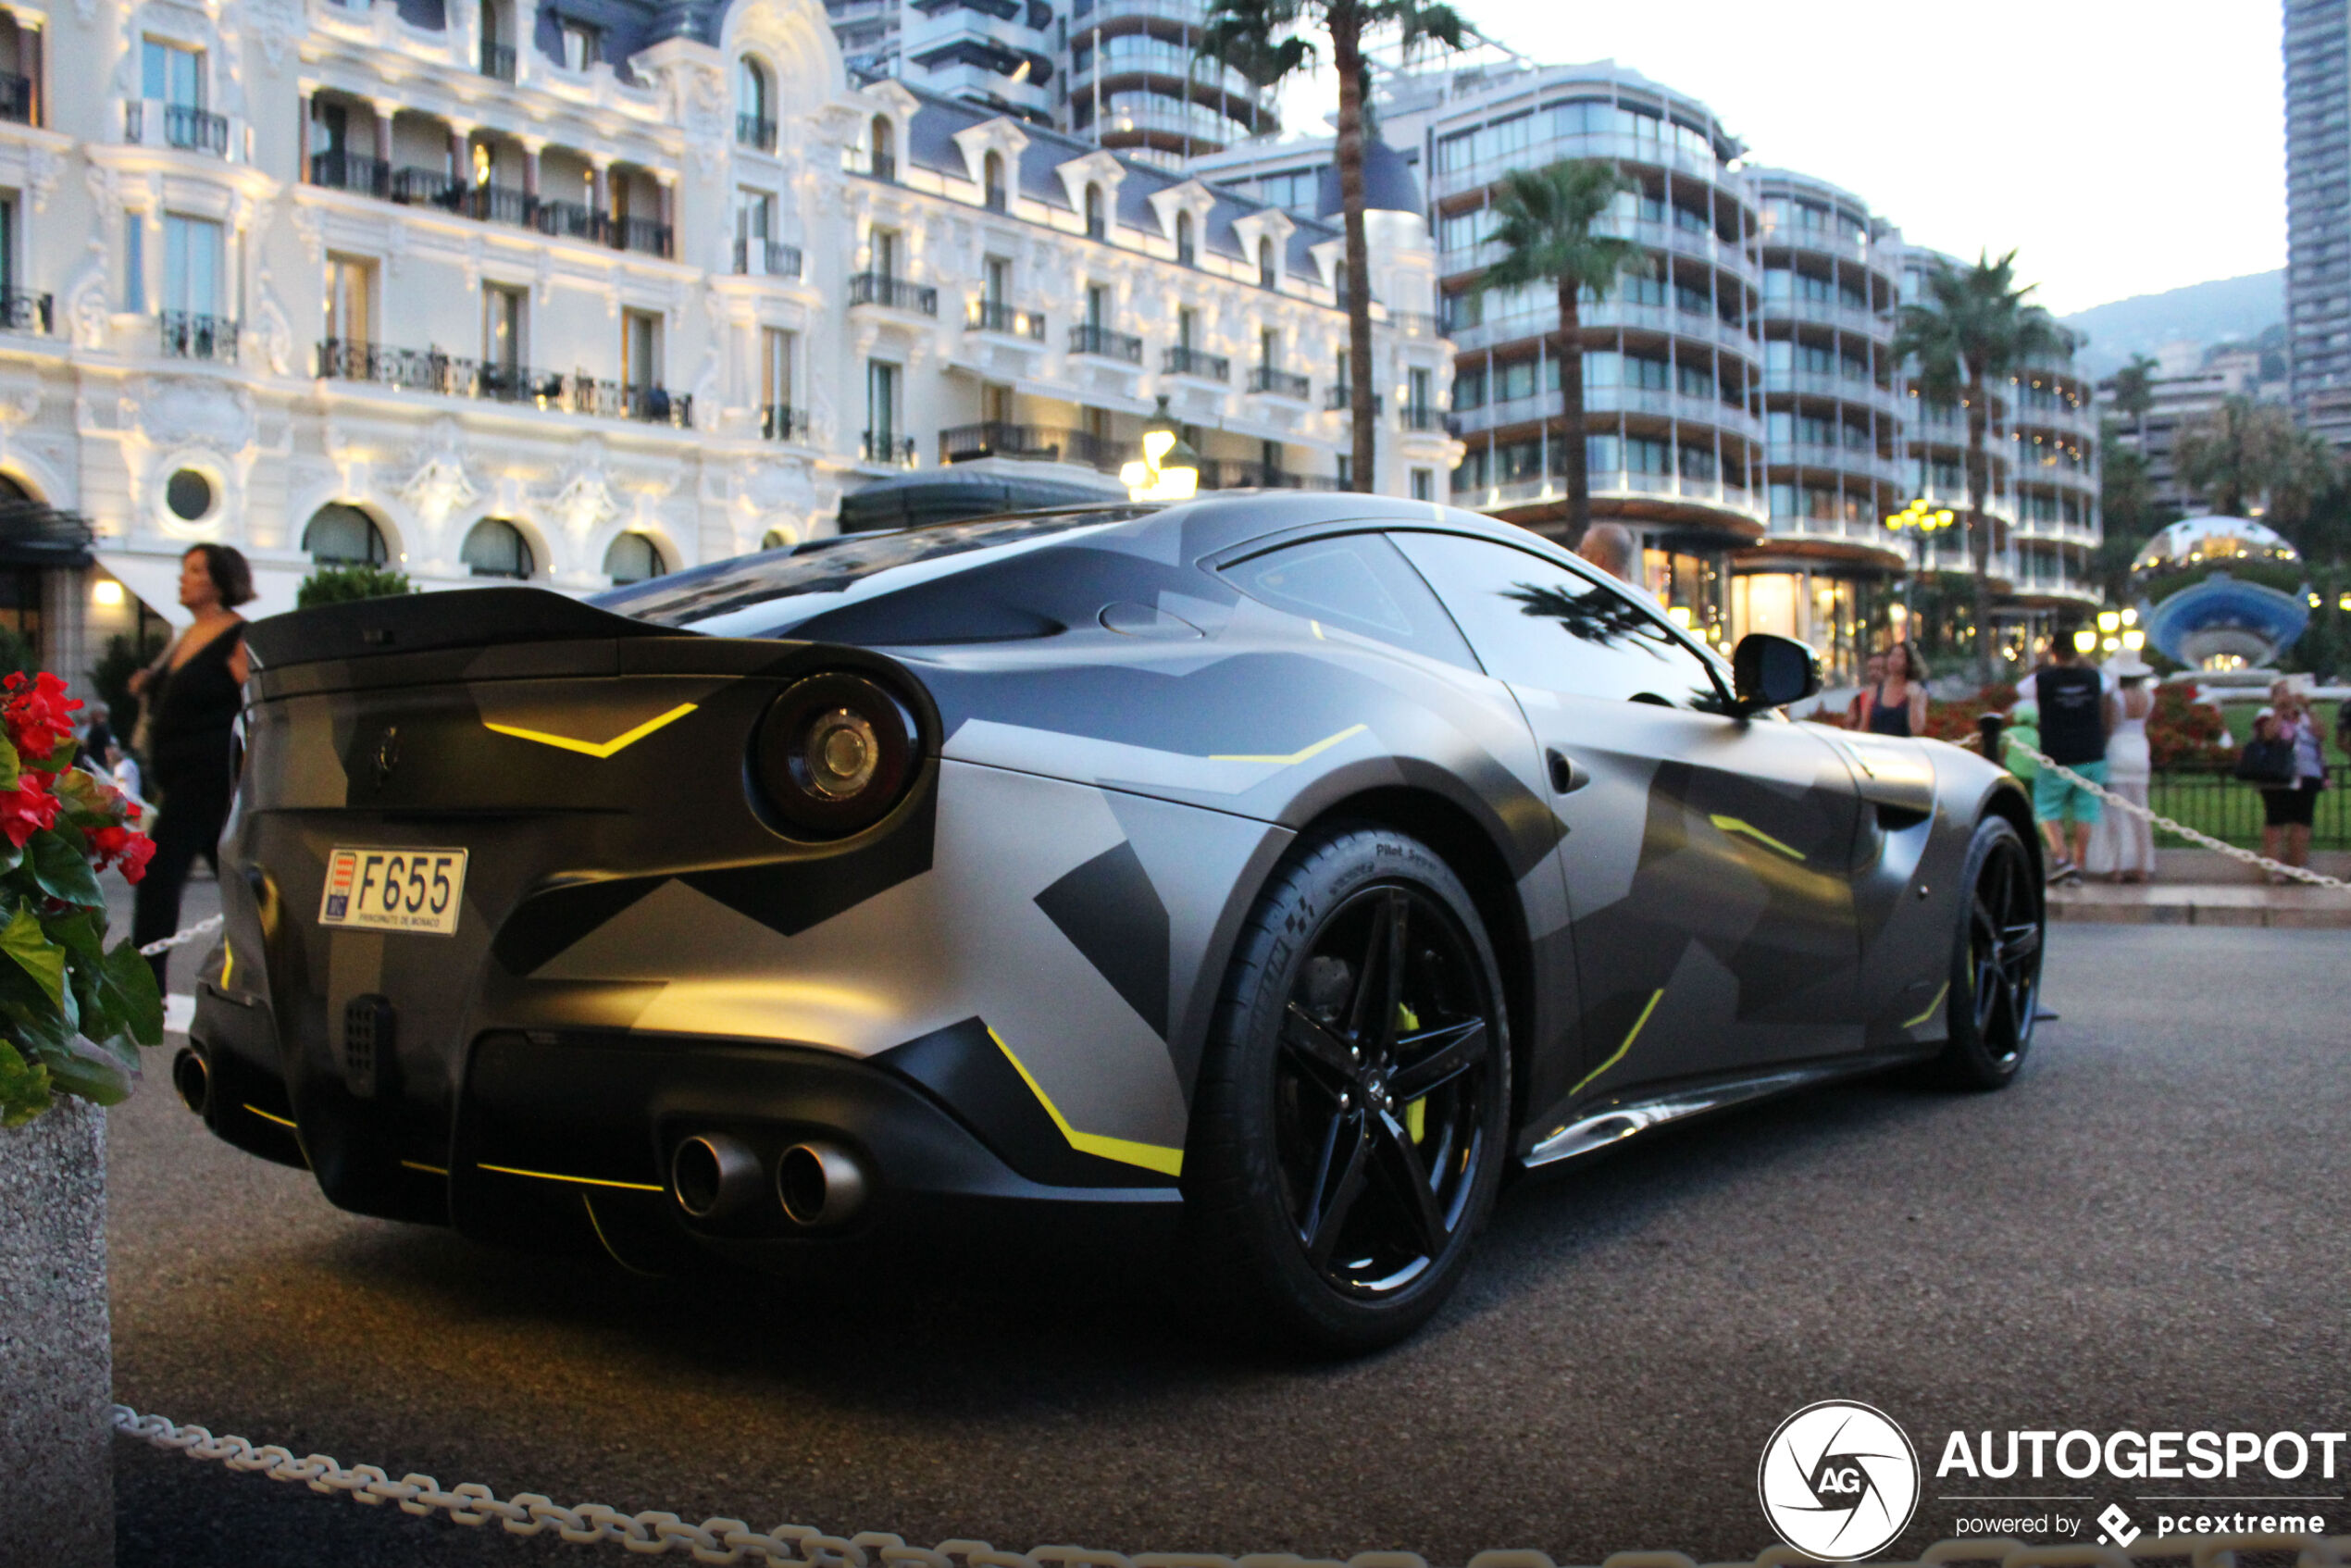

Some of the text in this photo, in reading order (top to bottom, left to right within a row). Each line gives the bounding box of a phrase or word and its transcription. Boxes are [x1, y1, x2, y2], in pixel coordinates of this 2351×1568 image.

[1376, 843, 1402, 857] Pilot
[358, 856, 452, 914] F655
[401, 916, 408, 926] DE
[411, 918, 440, 927] MONACO
